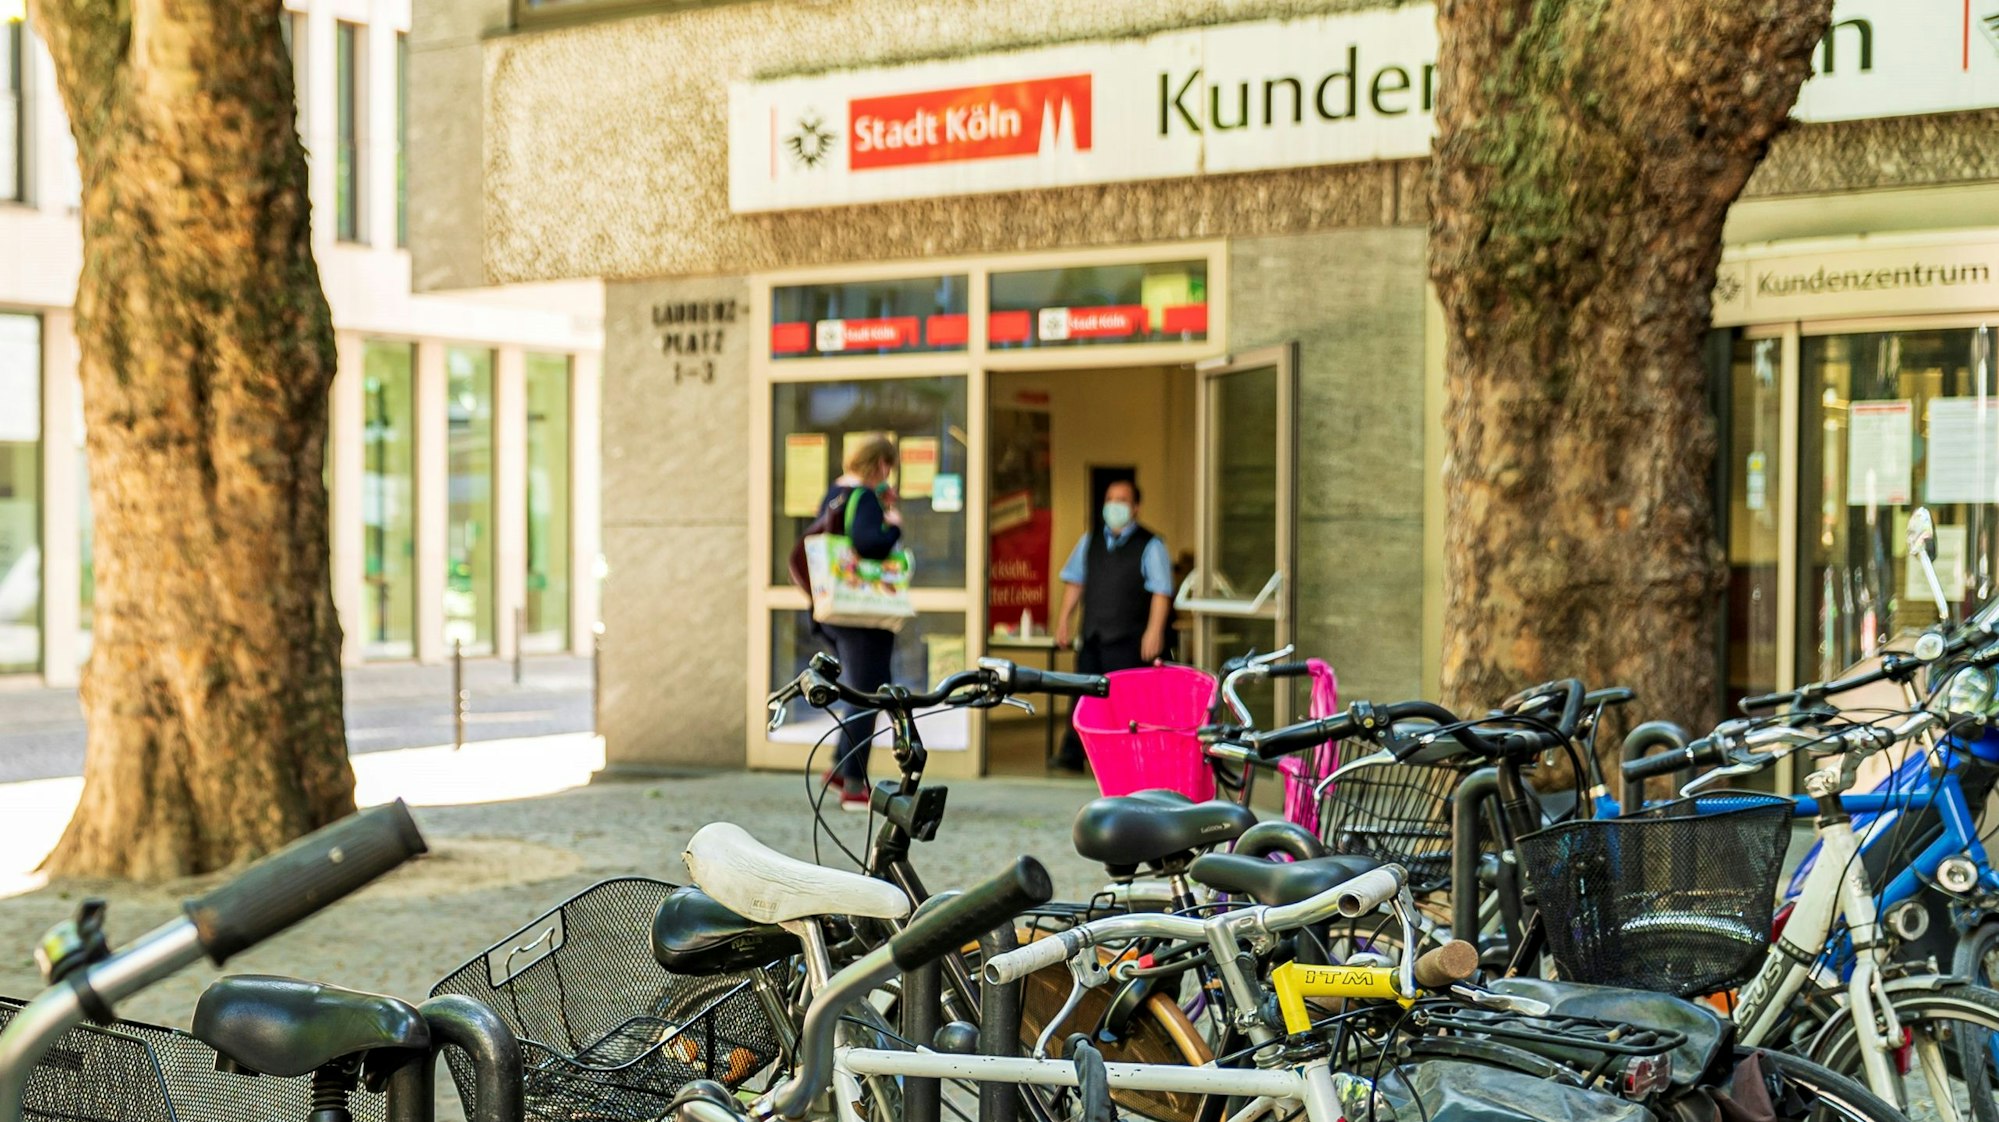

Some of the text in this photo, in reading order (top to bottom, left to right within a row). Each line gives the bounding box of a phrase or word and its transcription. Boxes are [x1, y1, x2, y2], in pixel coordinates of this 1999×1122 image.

[854, 101, 1022, 152] Stadt Köln
[1756, 262, 1990, 297] Kundenzentrum
[662, 329, 724, 355] PLATZ
[1305, 970, 1374, 985] ITM
[1737, 954, 1784, 1034] SUS
